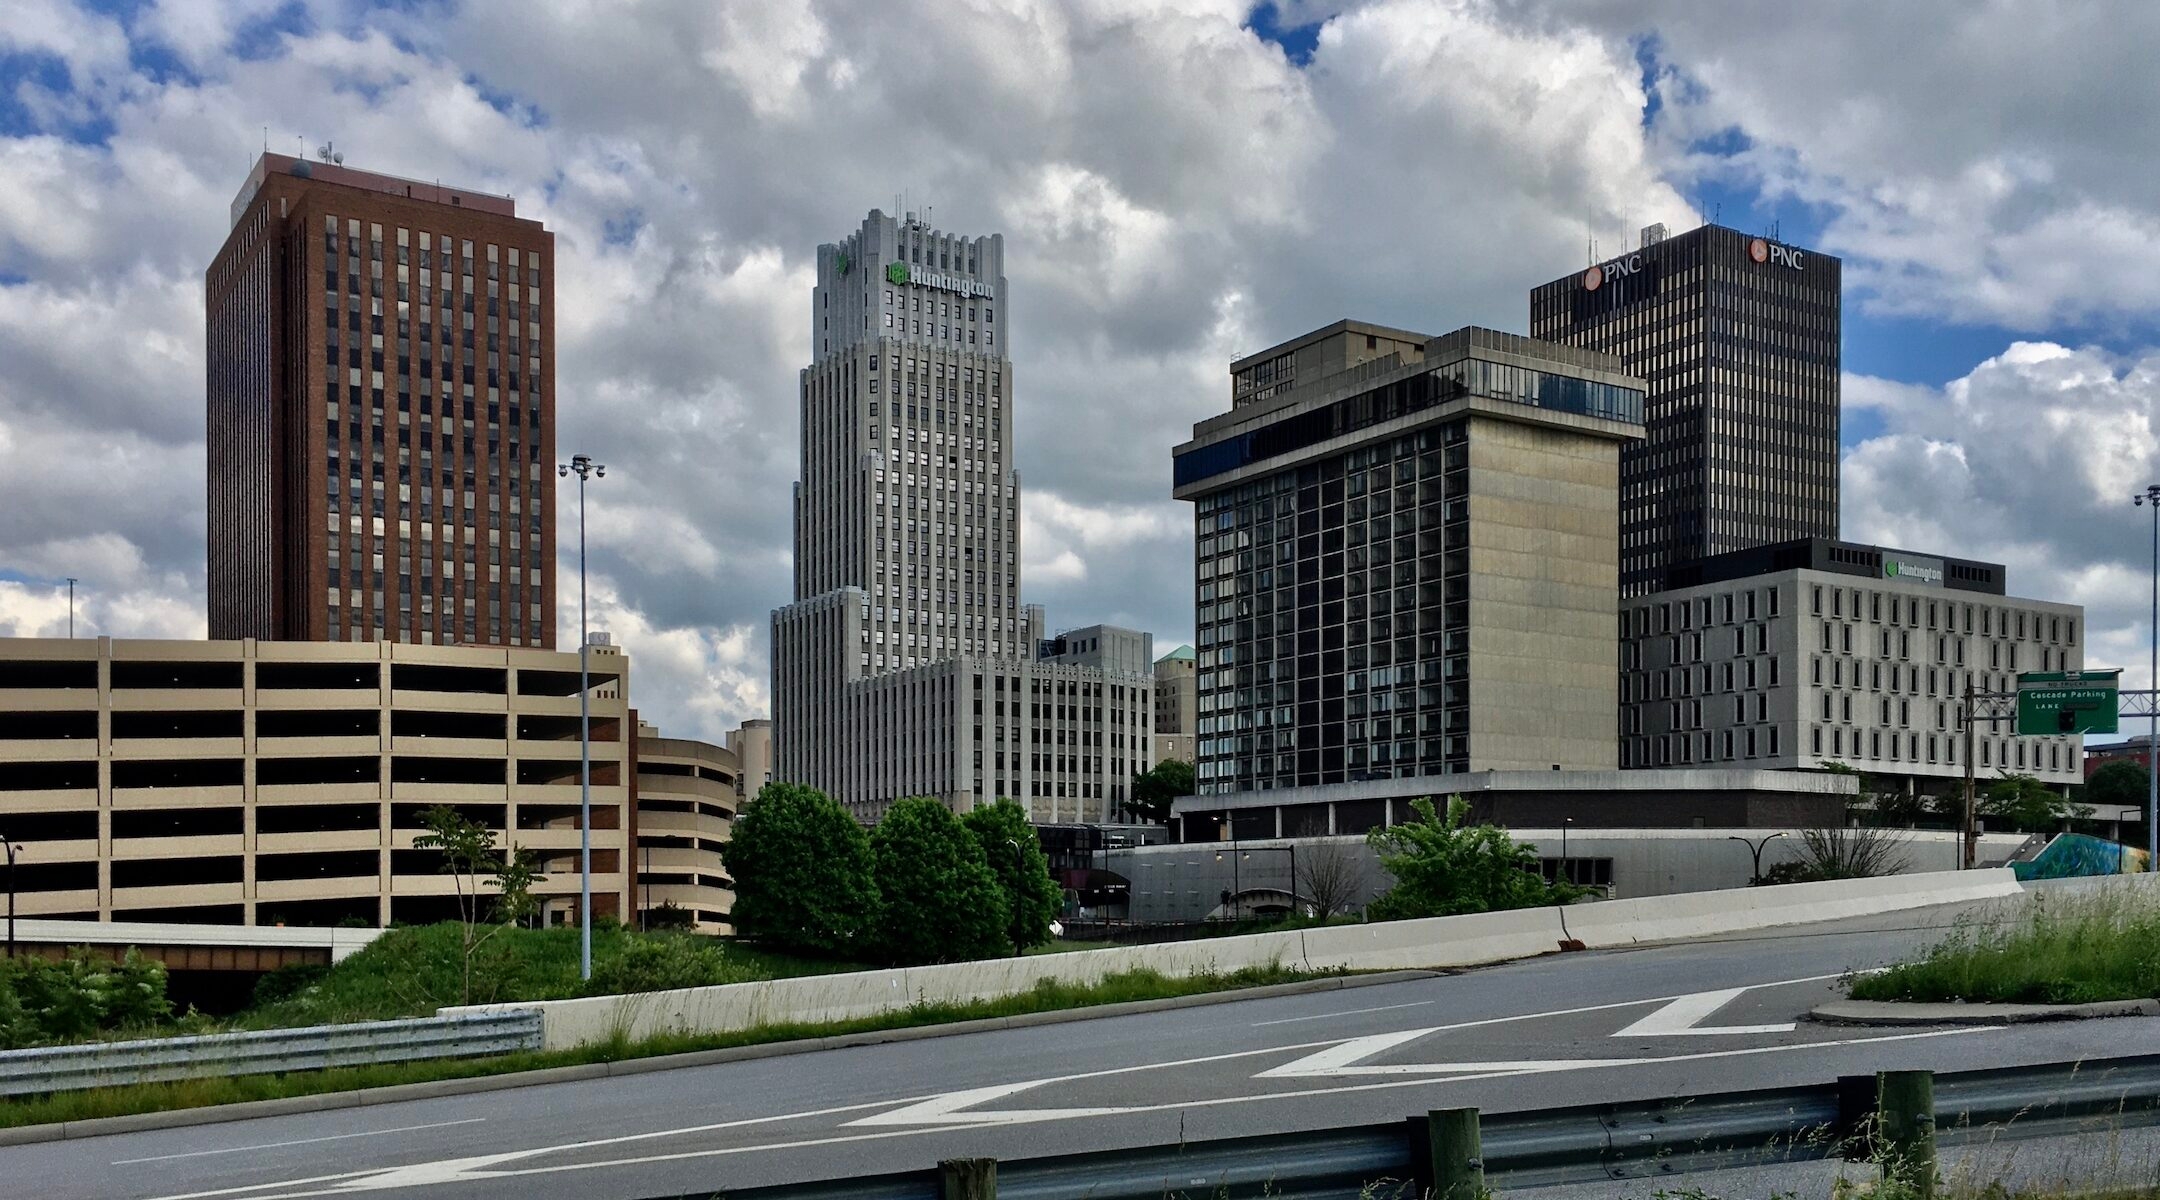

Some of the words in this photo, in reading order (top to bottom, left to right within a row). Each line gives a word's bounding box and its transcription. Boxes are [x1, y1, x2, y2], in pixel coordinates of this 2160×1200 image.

[1604, 254, 1641, 283] PNC
[1769, 244, 1803, 270] PNC
[910, 265, 994, 299] Huntington
[1898, 562, 1941, 582] Huntington
[2071, 691, 2106, 699] Parking
